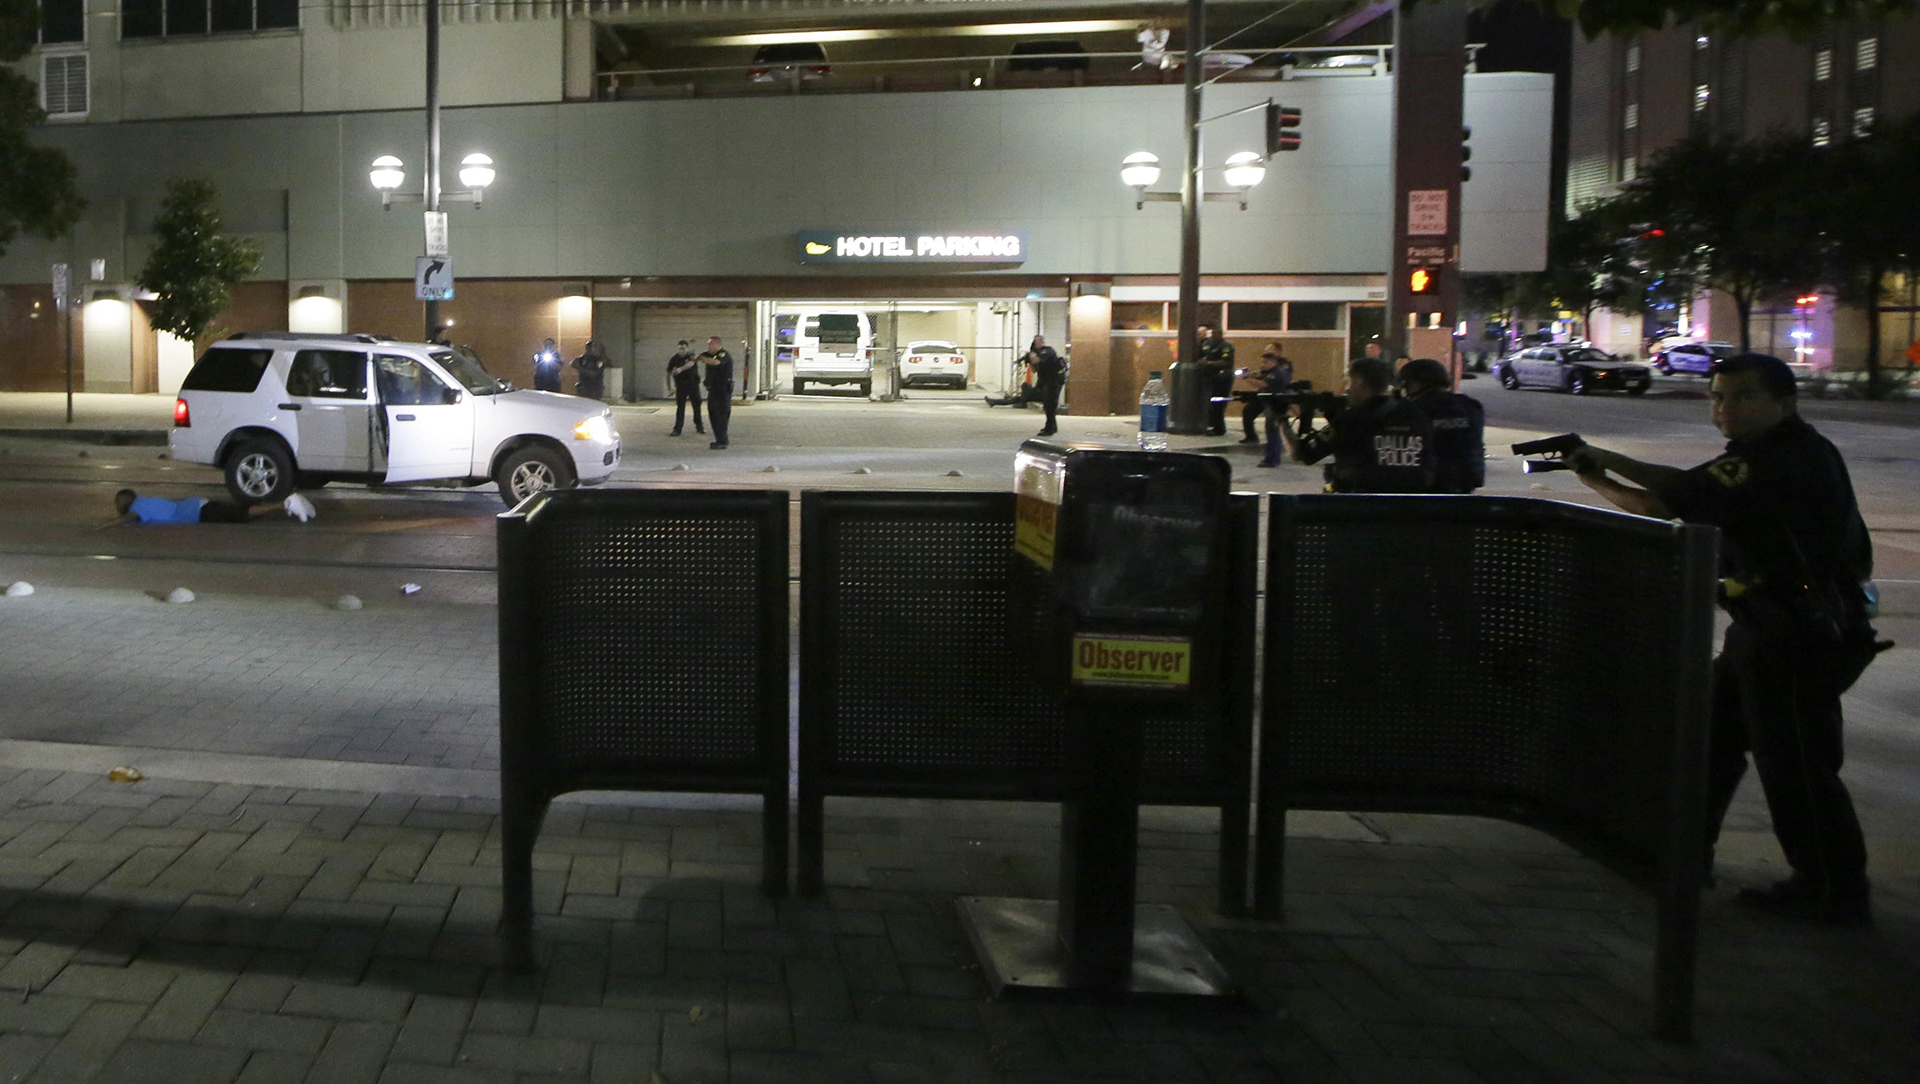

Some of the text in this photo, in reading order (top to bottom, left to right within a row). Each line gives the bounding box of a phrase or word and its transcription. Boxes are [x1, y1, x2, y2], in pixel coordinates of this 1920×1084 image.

[837, 235, 1020, 257] HOTEL PARKING
[422, 286, 448, 297] ONLY
[1432, 418, 1469, 429] POLICE
[1374, 435, 1423, 451] DALLAS
[1378, 450, 1420, 466] POLICE
[1079, 640, 1185, 673] Observer
